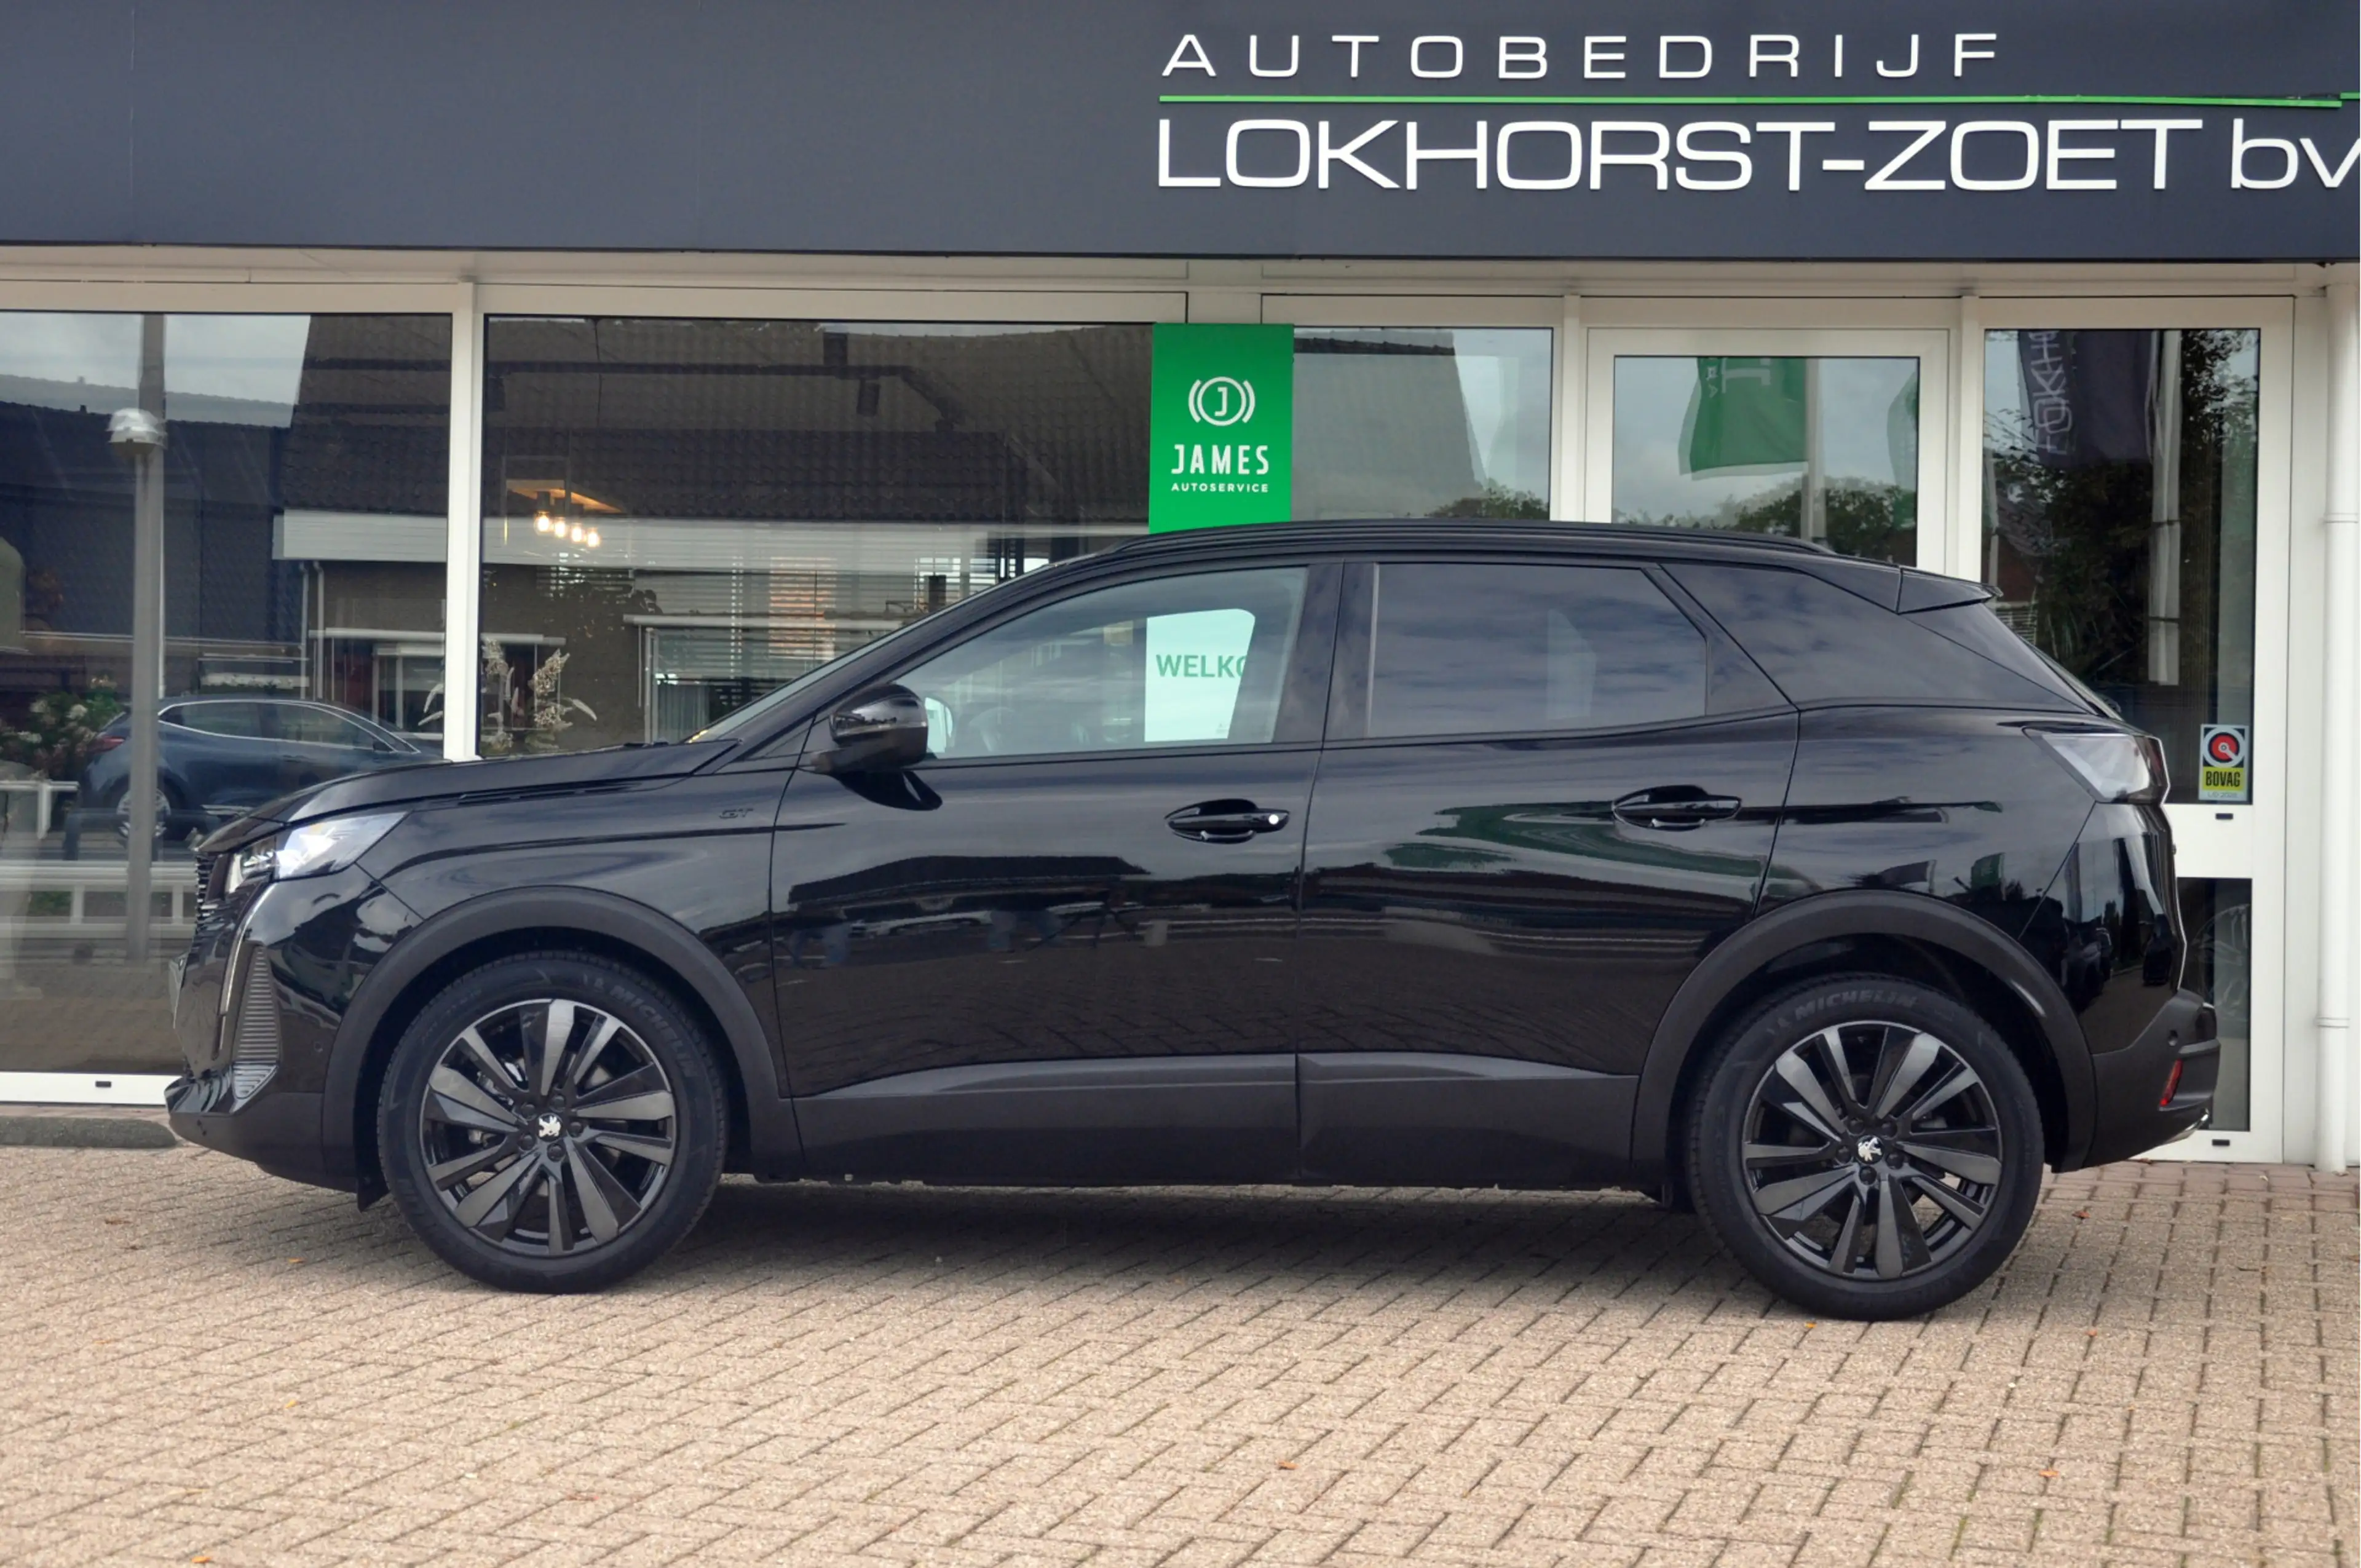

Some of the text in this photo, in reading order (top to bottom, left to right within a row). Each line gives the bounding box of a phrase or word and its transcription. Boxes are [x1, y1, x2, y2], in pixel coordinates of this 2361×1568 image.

[1161, 33, 1997, 79] AUTOBEDRIJF
[1158, 118, 2361, 191] LOKHORST-ZOET bv
[1171, 444, 1269, 475] JAMES
[1171, 482, 1268, 493] AUTOSERVICE
[2205, 771, 2240, 787] BOVAG
[719, 807, 754, 819] GT
[1795, 989, 1919, 1021] MICHELIN
